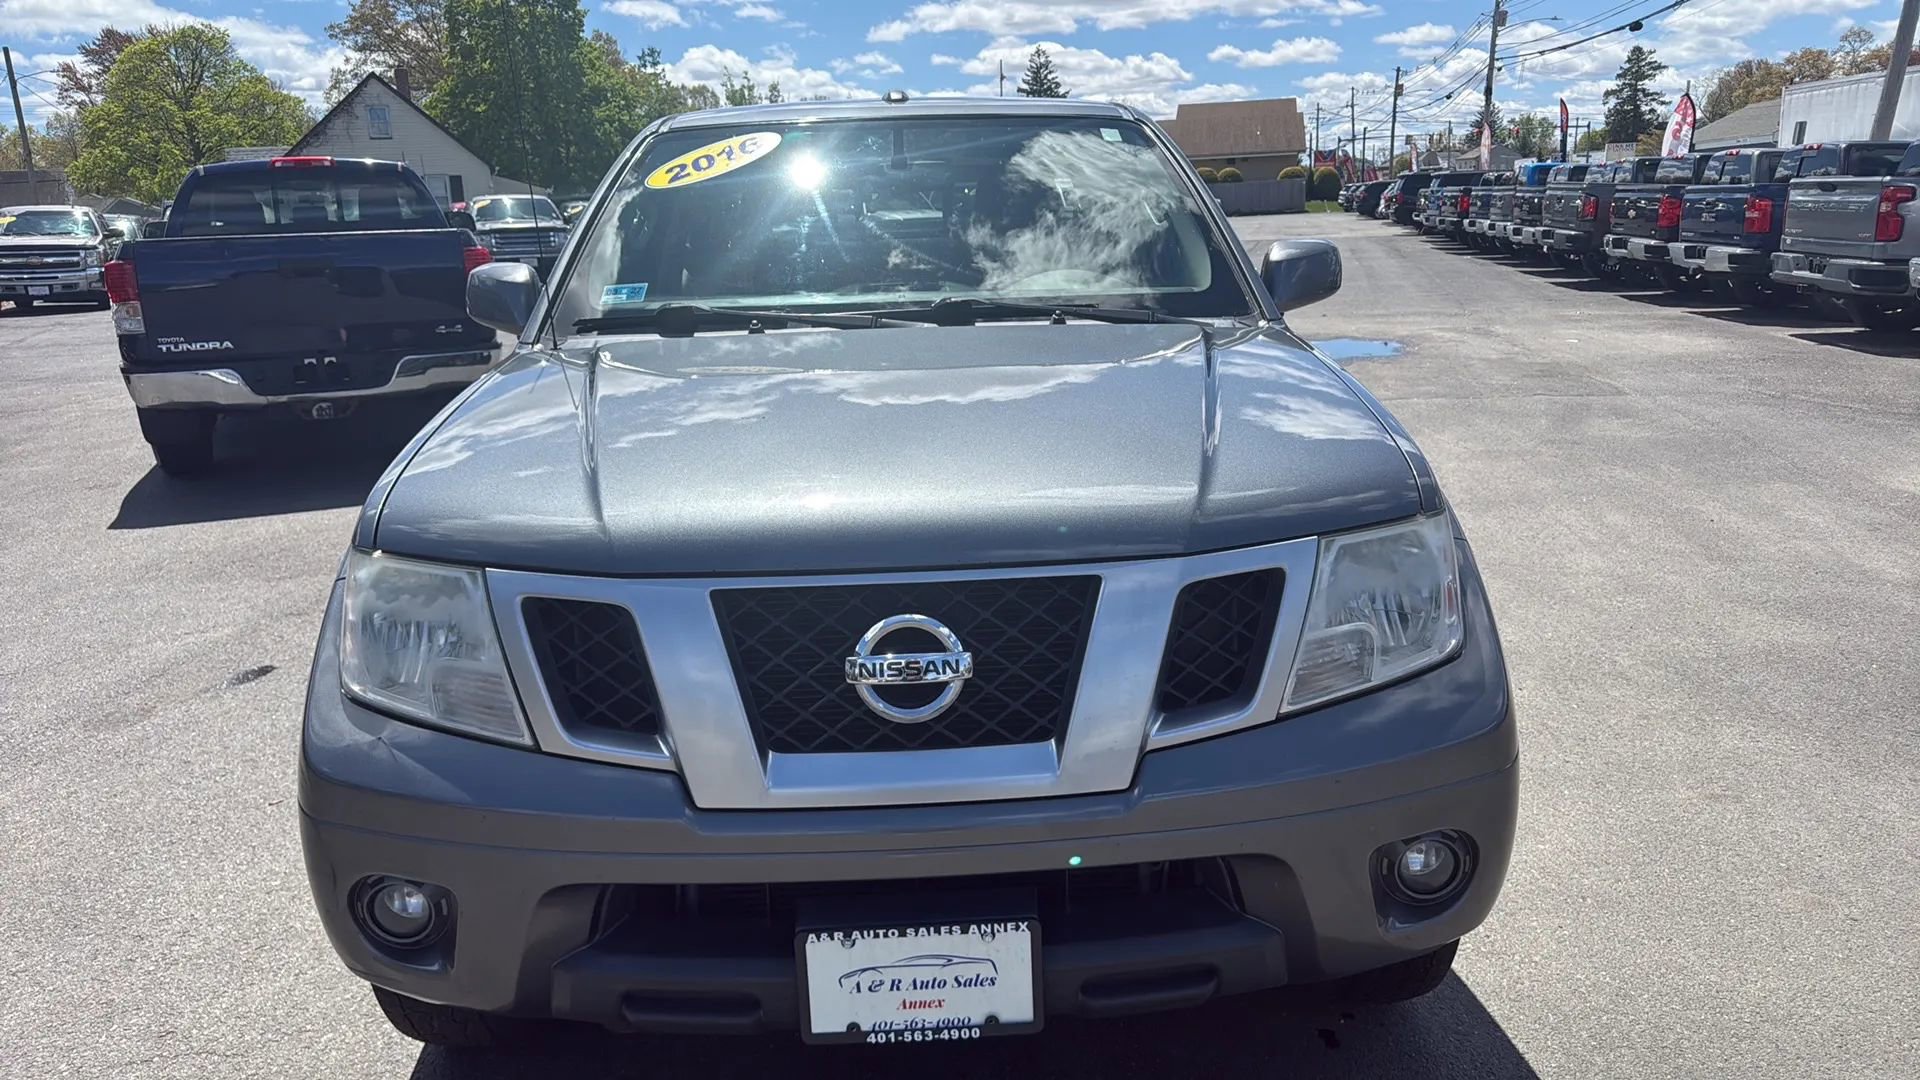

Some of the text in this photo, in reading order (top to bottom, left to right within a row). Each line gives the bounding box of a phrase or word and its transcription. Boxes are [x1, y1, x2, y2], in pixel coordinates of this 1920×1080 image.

[157, 340, 234, 353] TUNDRA
[858, 658, 960, 680] NISSAN
[807, 921, 1028, 943] A&R AUTO SALES ANNEX
[849, 973, 998, 994] A & R Auto Sales
[896, 998, 946, 1011] Annex
[866, 1027, 981, 1044] 401-563-4900
